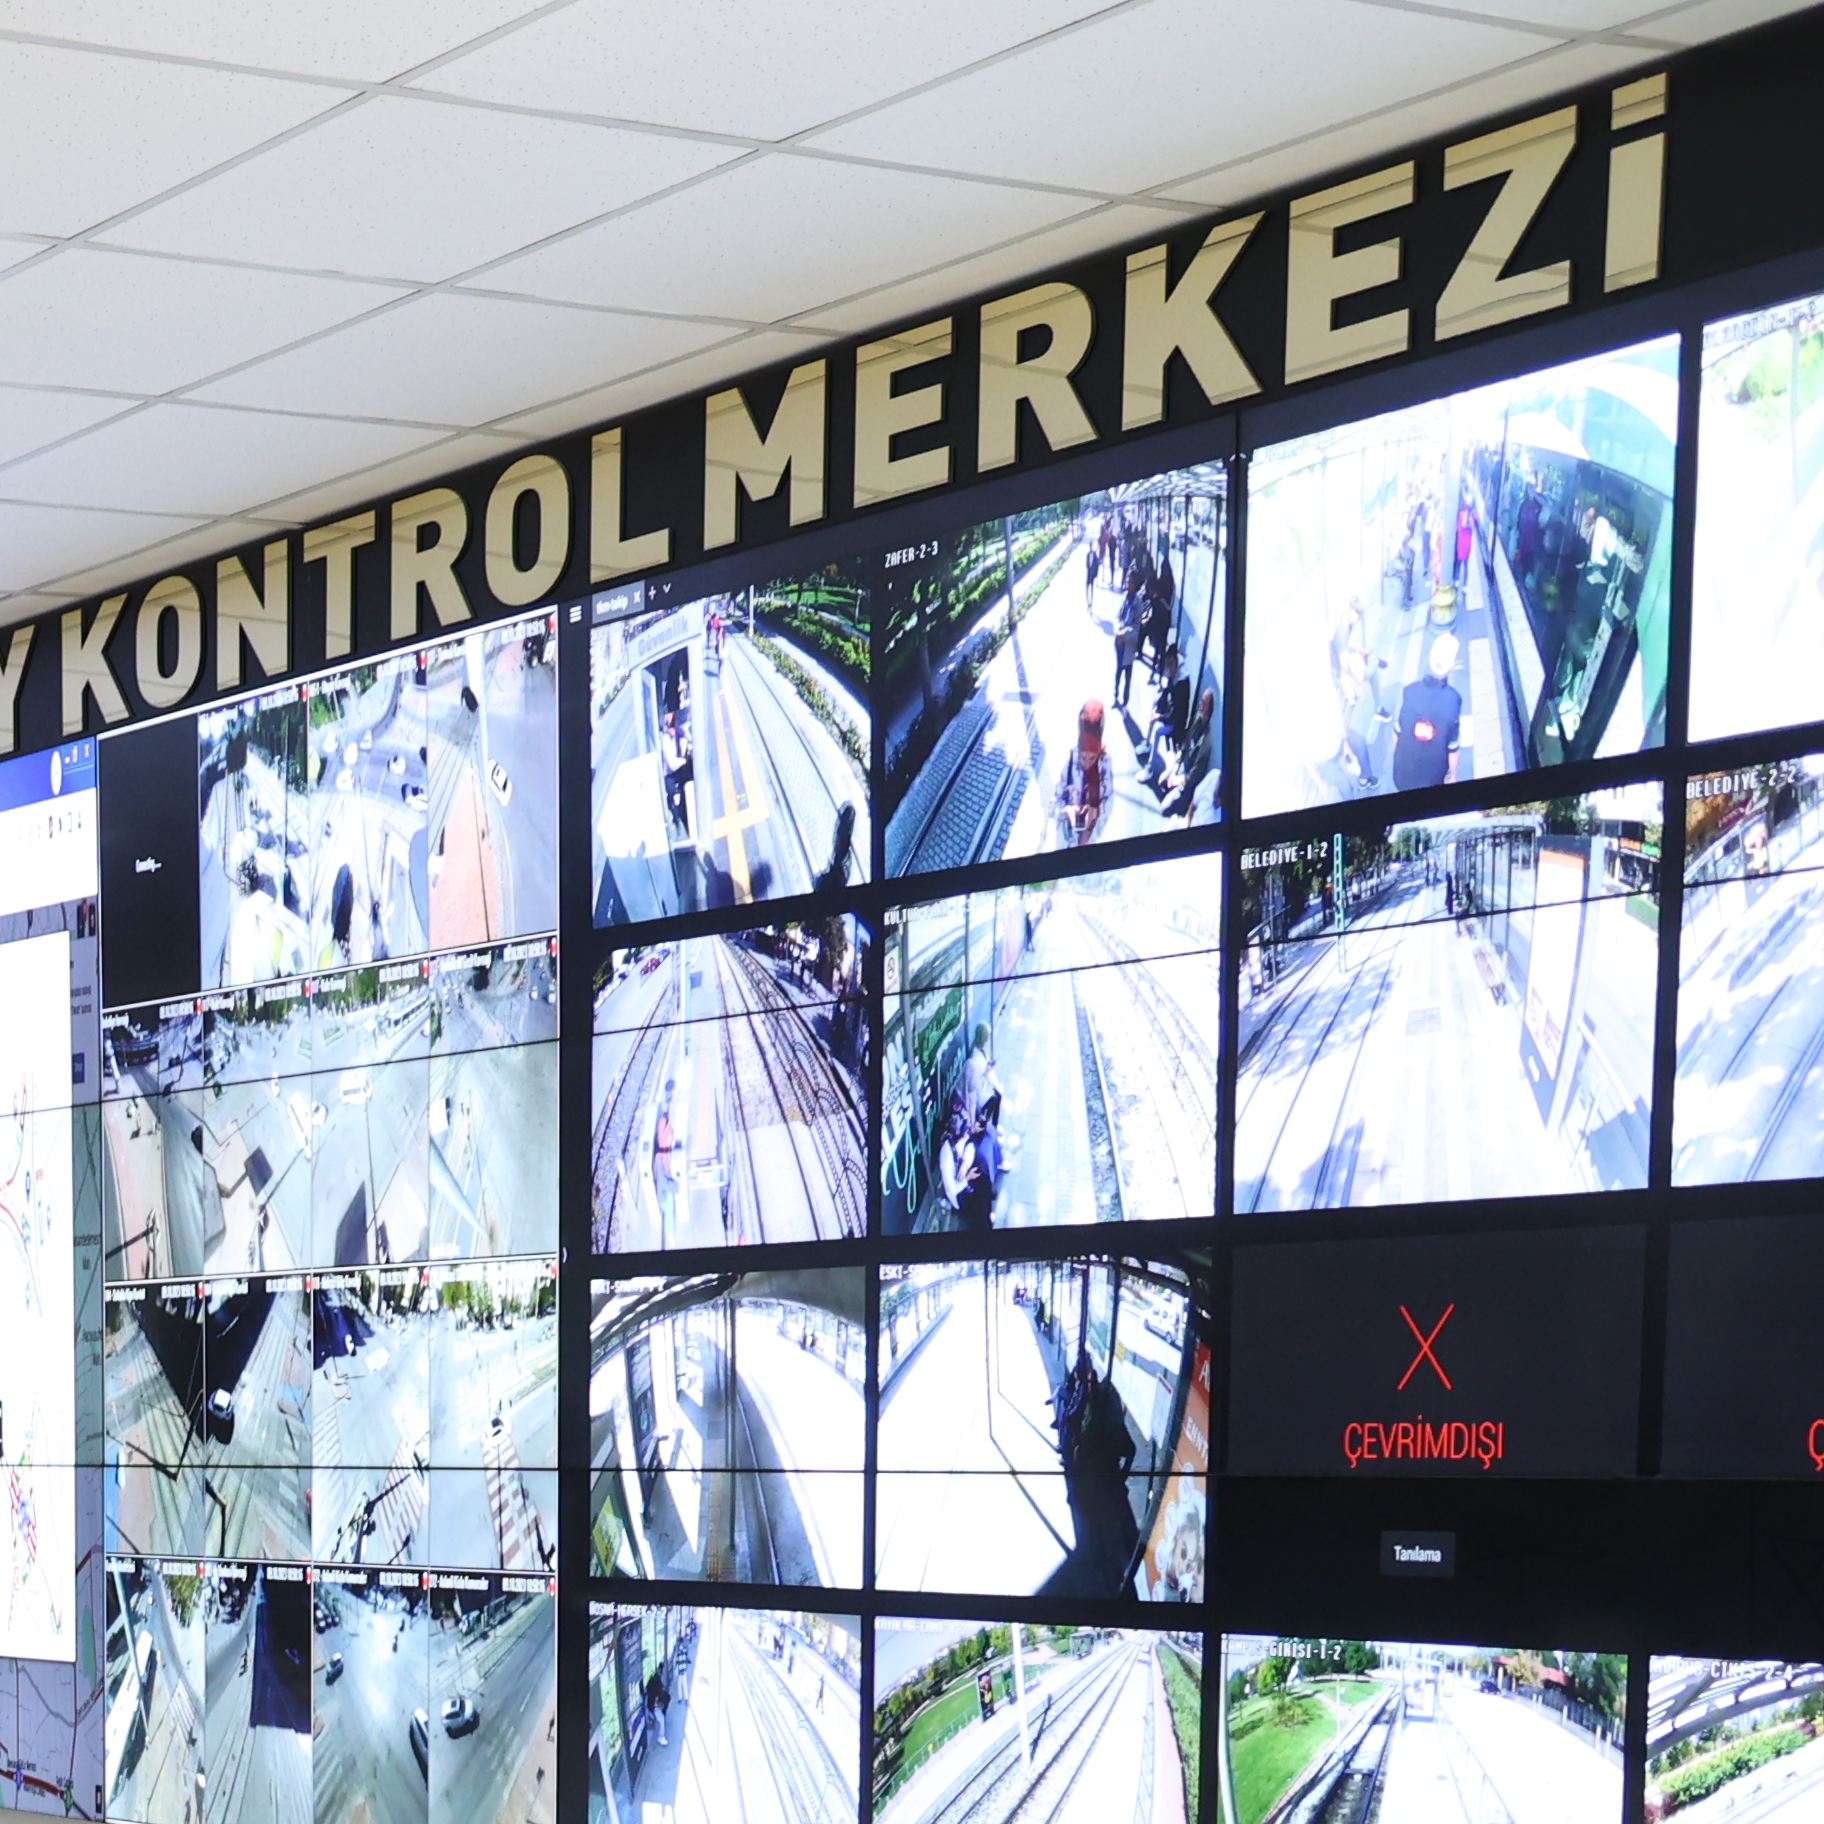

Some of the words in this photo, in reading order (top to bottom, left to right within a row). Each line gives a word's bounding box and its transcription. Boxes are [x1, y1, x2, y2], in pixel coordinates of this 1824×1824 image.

[60, 427, 670, 736] KONTROL
[704, 72, 1668, 551] MERKEZİ
[884, 541, 939, 568] ZAFER-2-3
[638, 616, 689, 656] Güvenlik
[1686, 766, 1797, 799] BELEDIYE-2-2
[1241, 842, 1328, 870] BELEDIYE-1-2
[1342, 1414, 1505, 1470] ÇEVRİMDIŞI
[1393, 1545, 1442, 1562] Tanılama
